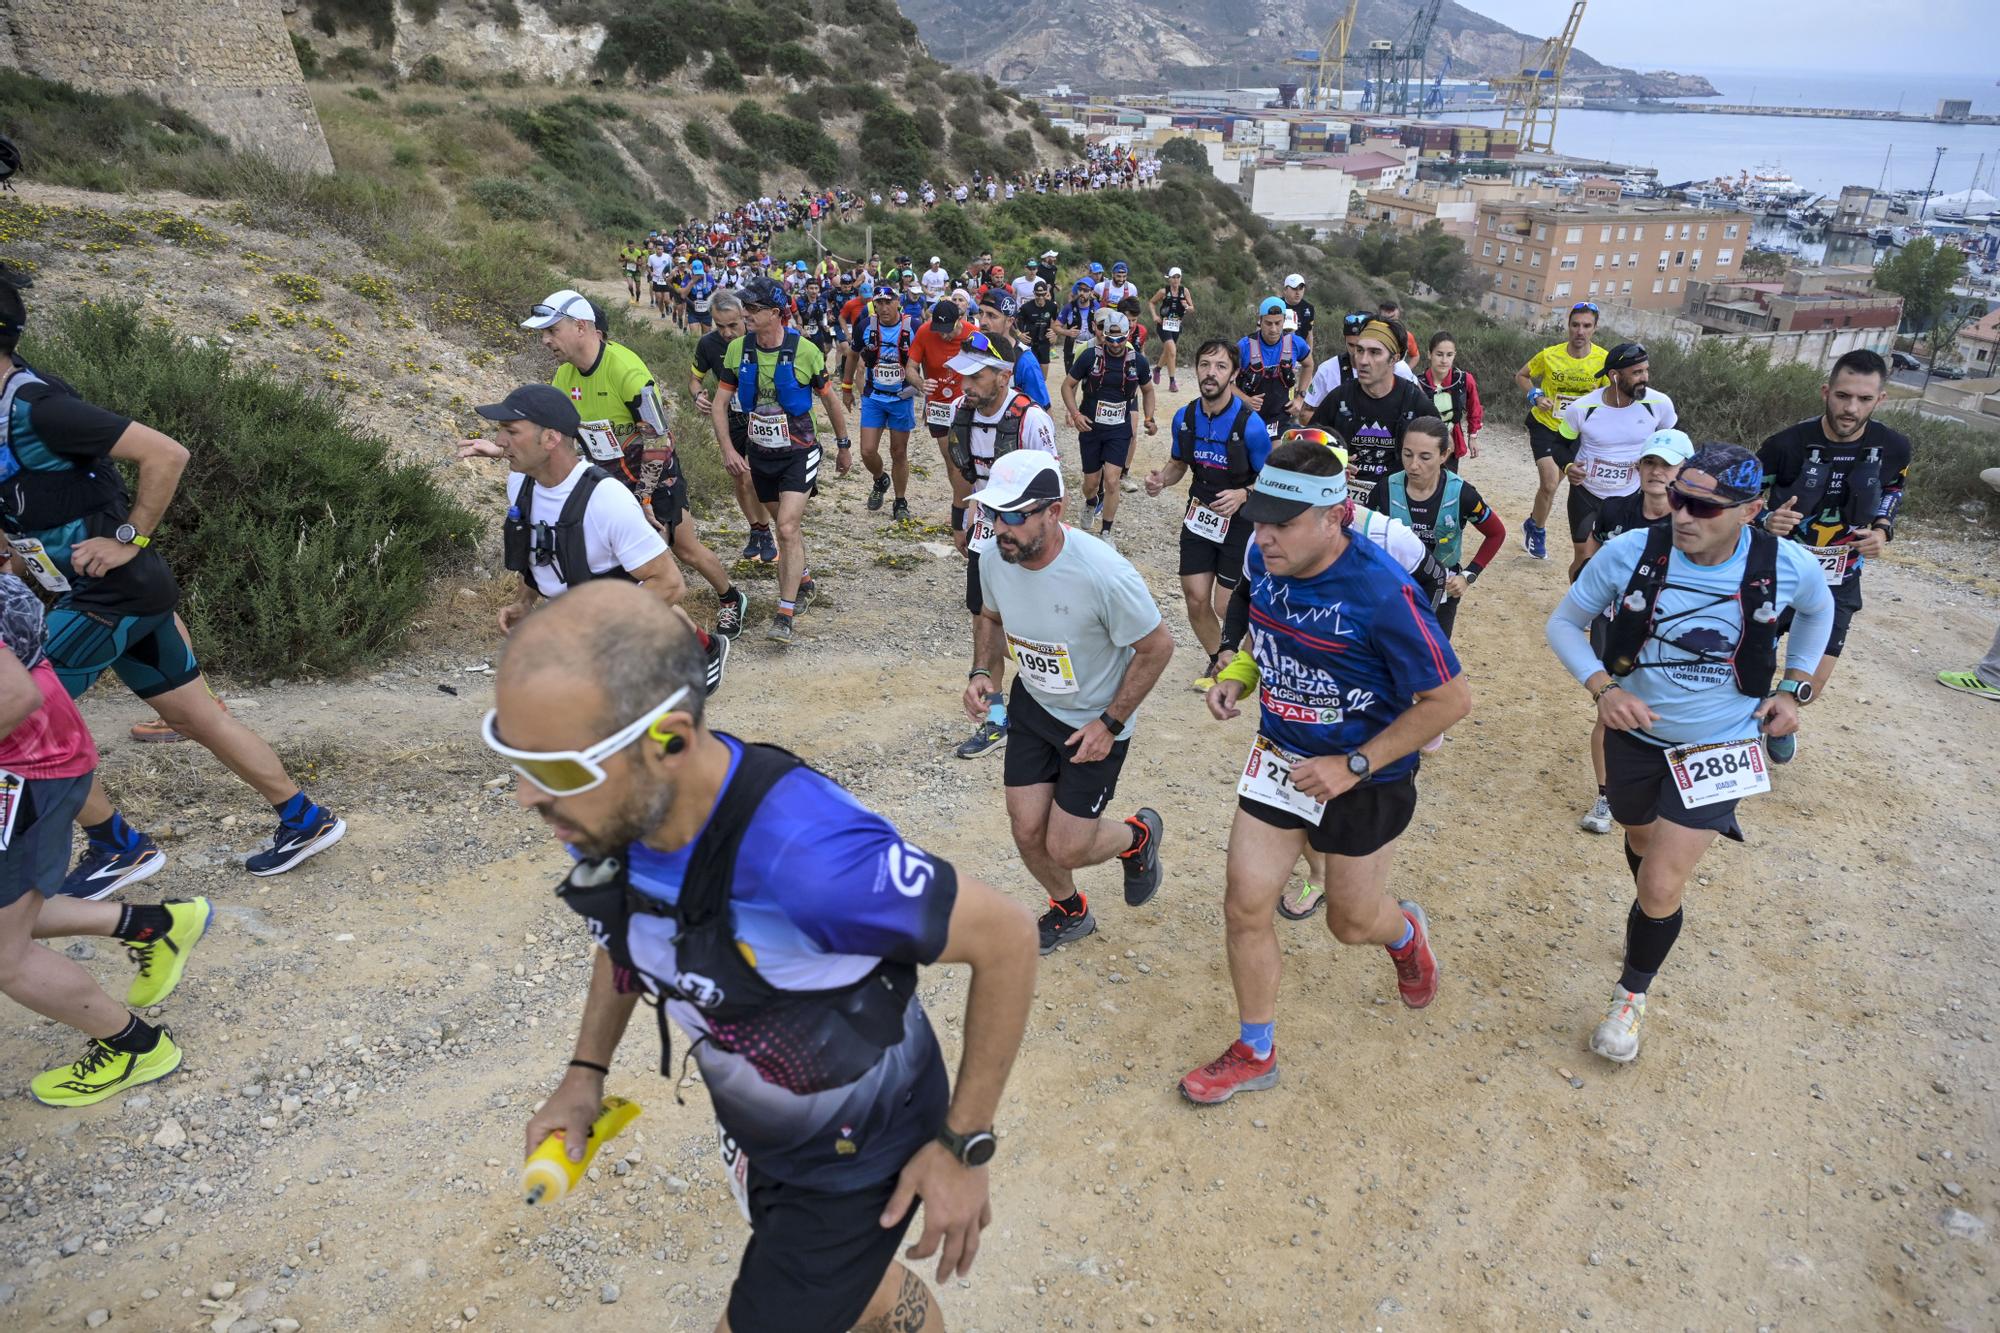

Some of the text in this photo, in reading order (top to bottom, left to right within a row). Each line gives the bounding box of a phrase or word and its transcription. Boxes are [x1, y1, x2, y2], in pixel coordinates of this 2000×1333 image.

[880, 370, 900, 378] 1010
[930, 408, 951, 418] 3635
[1101, 409, 1122, 417] 3047
[753, 424, 780, 436] 3851
[589, 433, 597, 446] 5
[1597, 467, 1627, 479] 2235
[1260, 477, 1303, 494] LURBEL
[1197, 511, 1219, 528] 854
[1037, 645, 1055, 654] 2023
[1017, 651, 1060, 675] 1995
[1672, 672, 1722, 684] LORCA TRAIL
[1308, 695, 1340, 707] 2020
[1689, 750, 1751, 782] 2884
